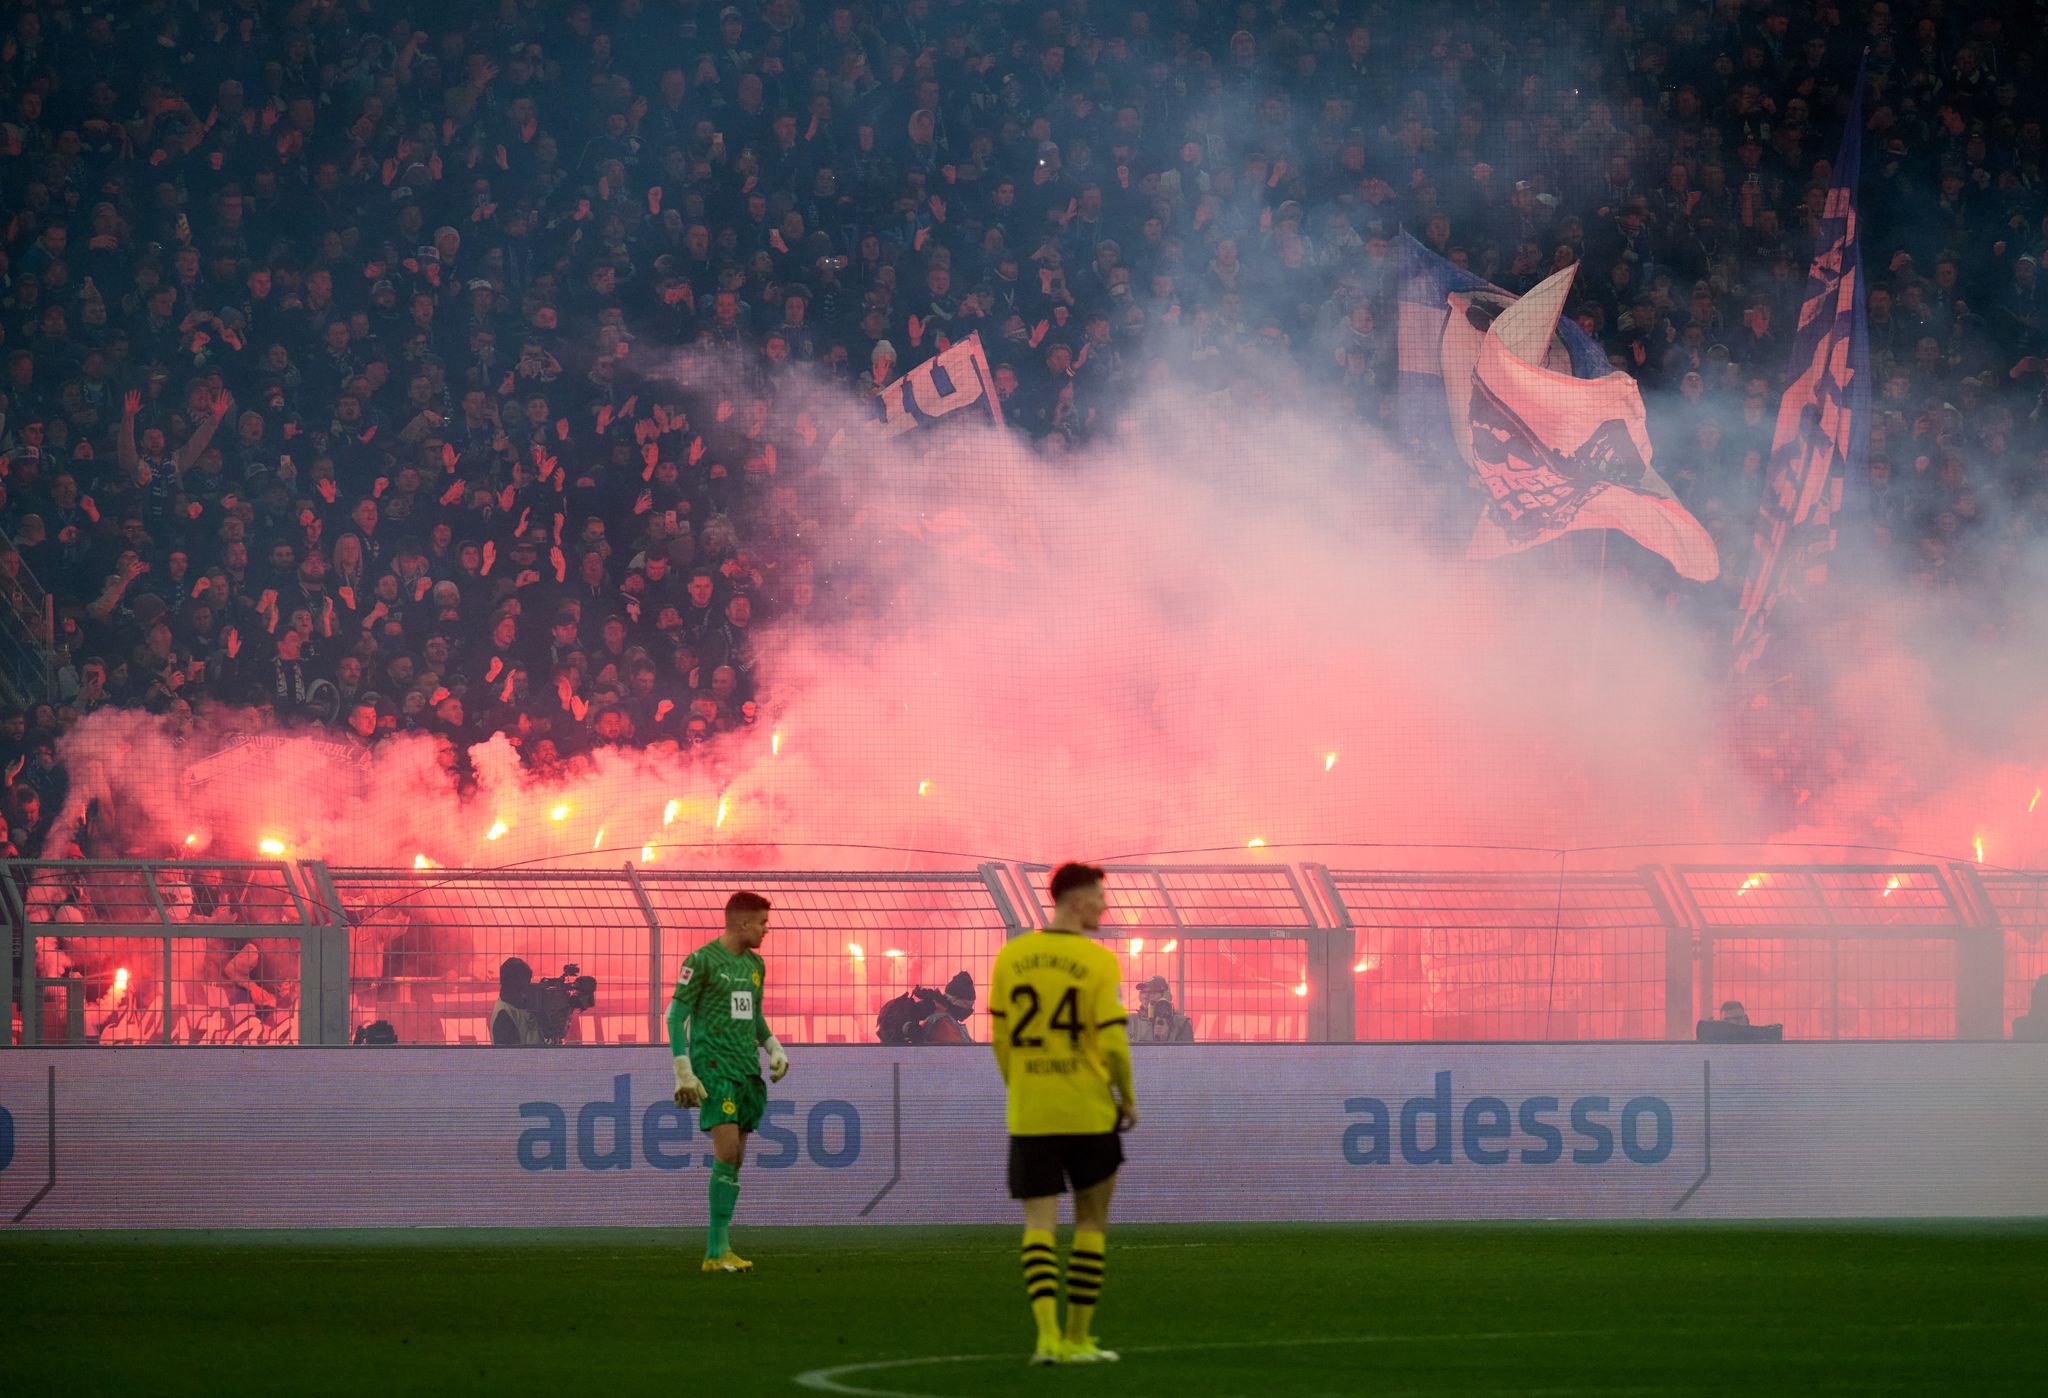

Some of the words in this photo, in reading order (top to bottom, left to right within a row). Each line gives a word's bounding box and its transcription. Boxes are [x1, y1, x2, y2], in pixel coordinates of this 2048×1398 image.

[733, 998, 751, 1012] 1&1
[1010, 983, 1086, 1050] 24
[517, 1073, 861, 1170] adeso
[1342, 1070, 1673, 1165] adesso
